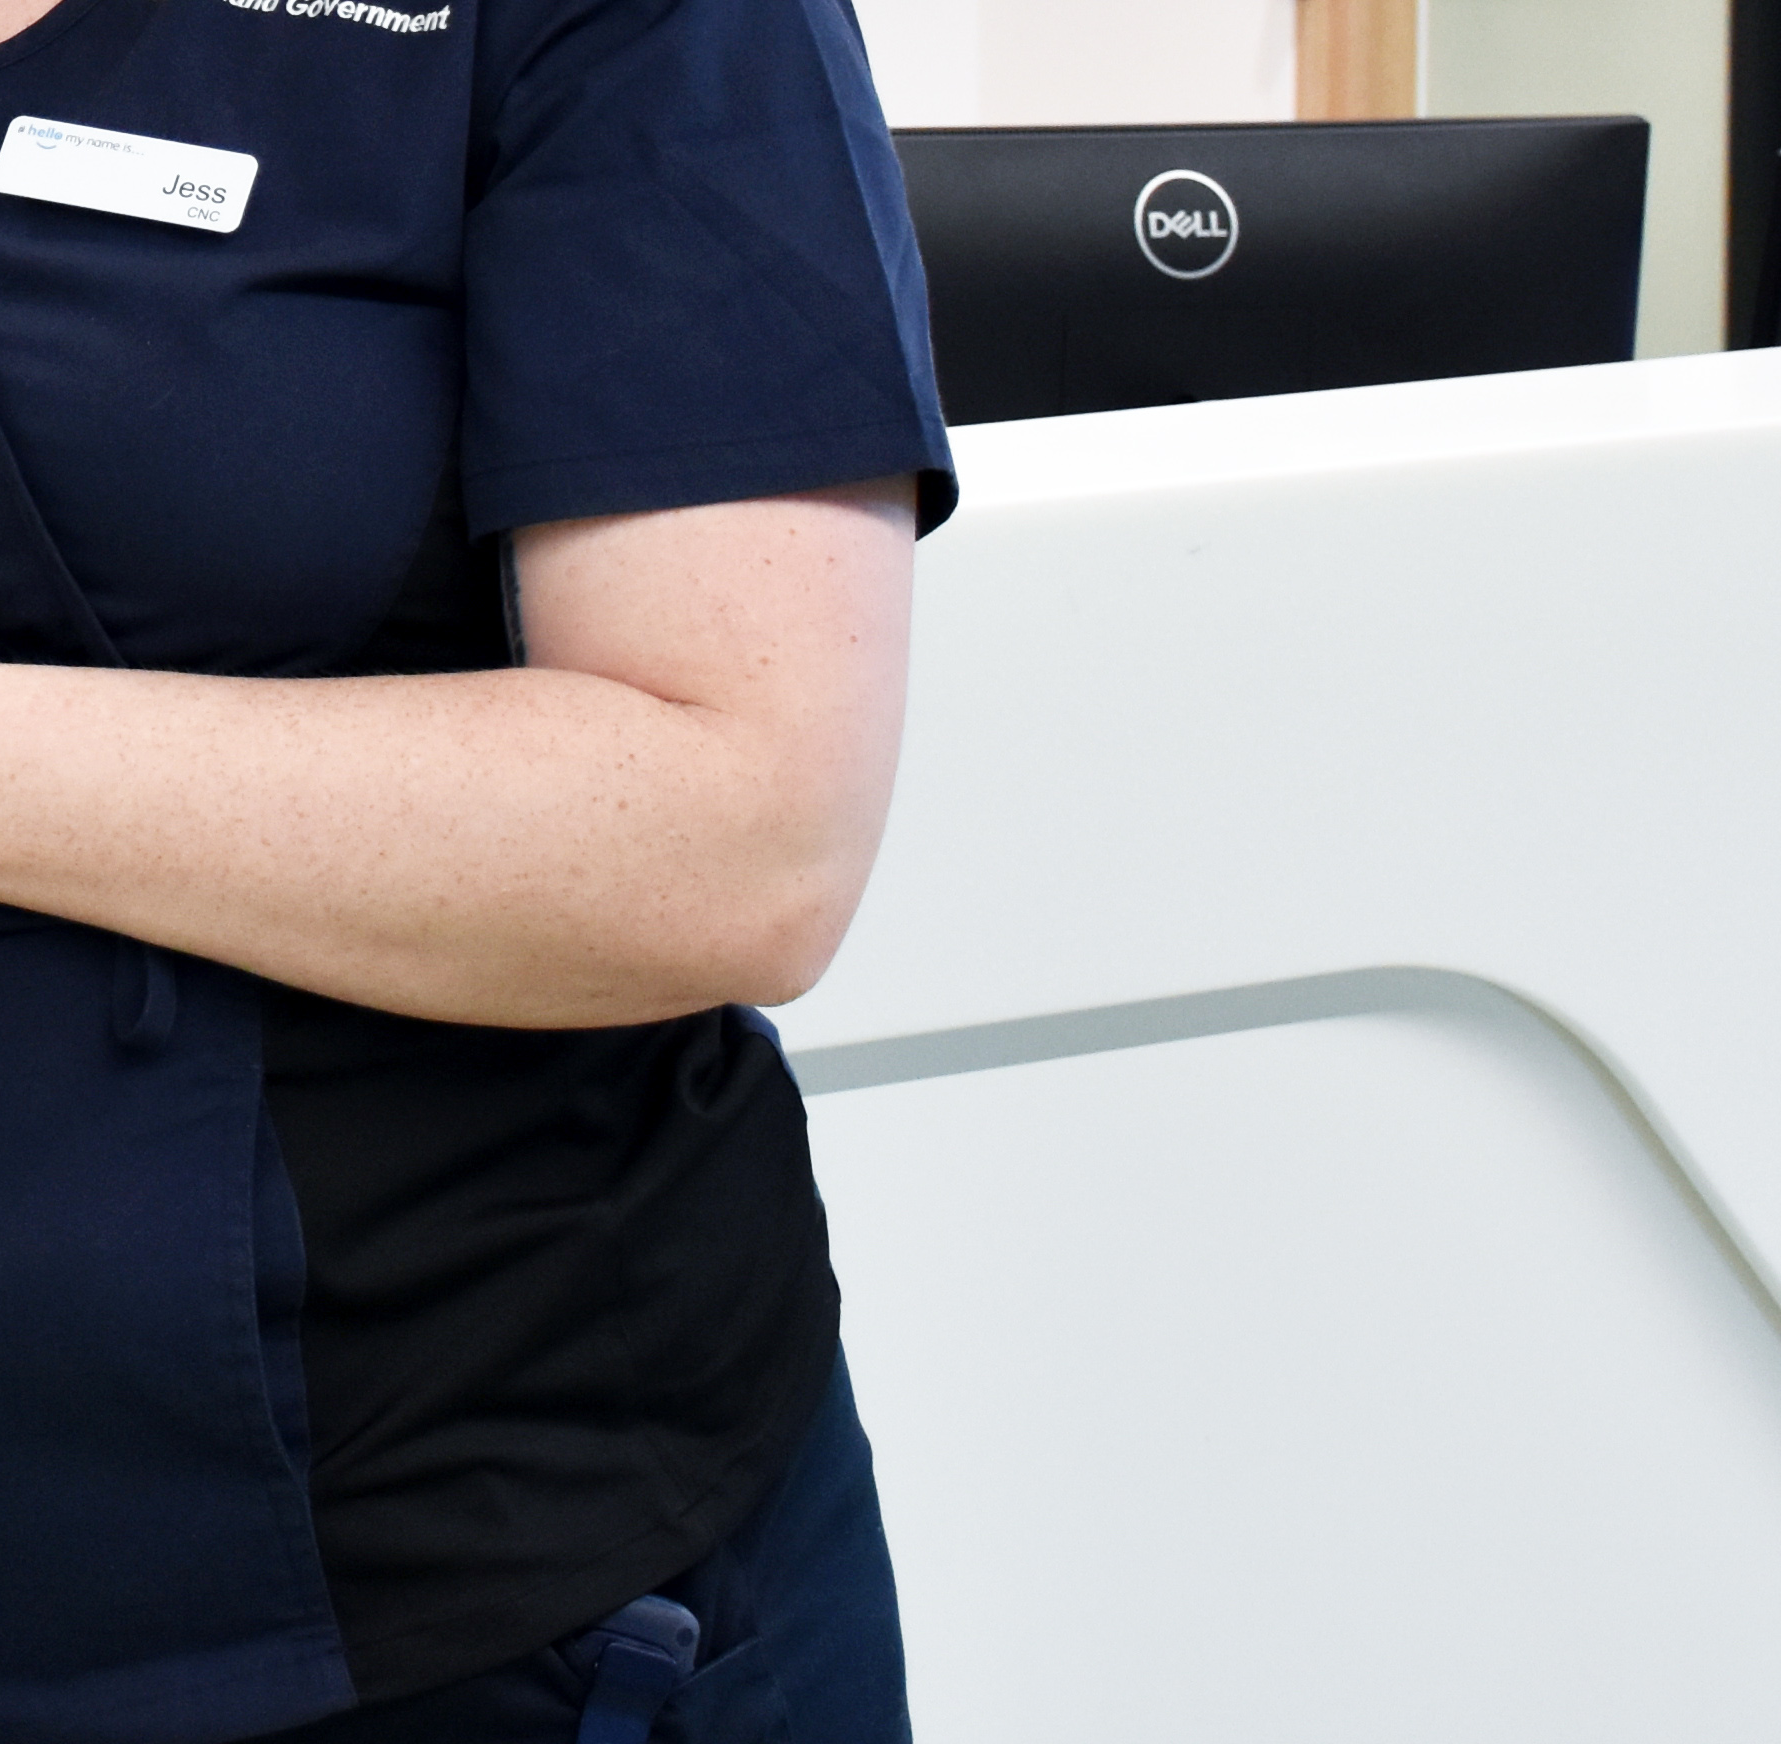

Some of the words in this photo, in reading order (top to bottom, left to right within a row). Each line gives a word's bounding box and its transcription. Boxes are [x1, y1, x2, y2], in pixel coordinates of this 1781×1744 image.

[86, 138, 121, 152] name
[162, 174, 227, 204] Jess
[187, 206, 221, 222] CNC
[1147, 209, 1228, 239] DELL
